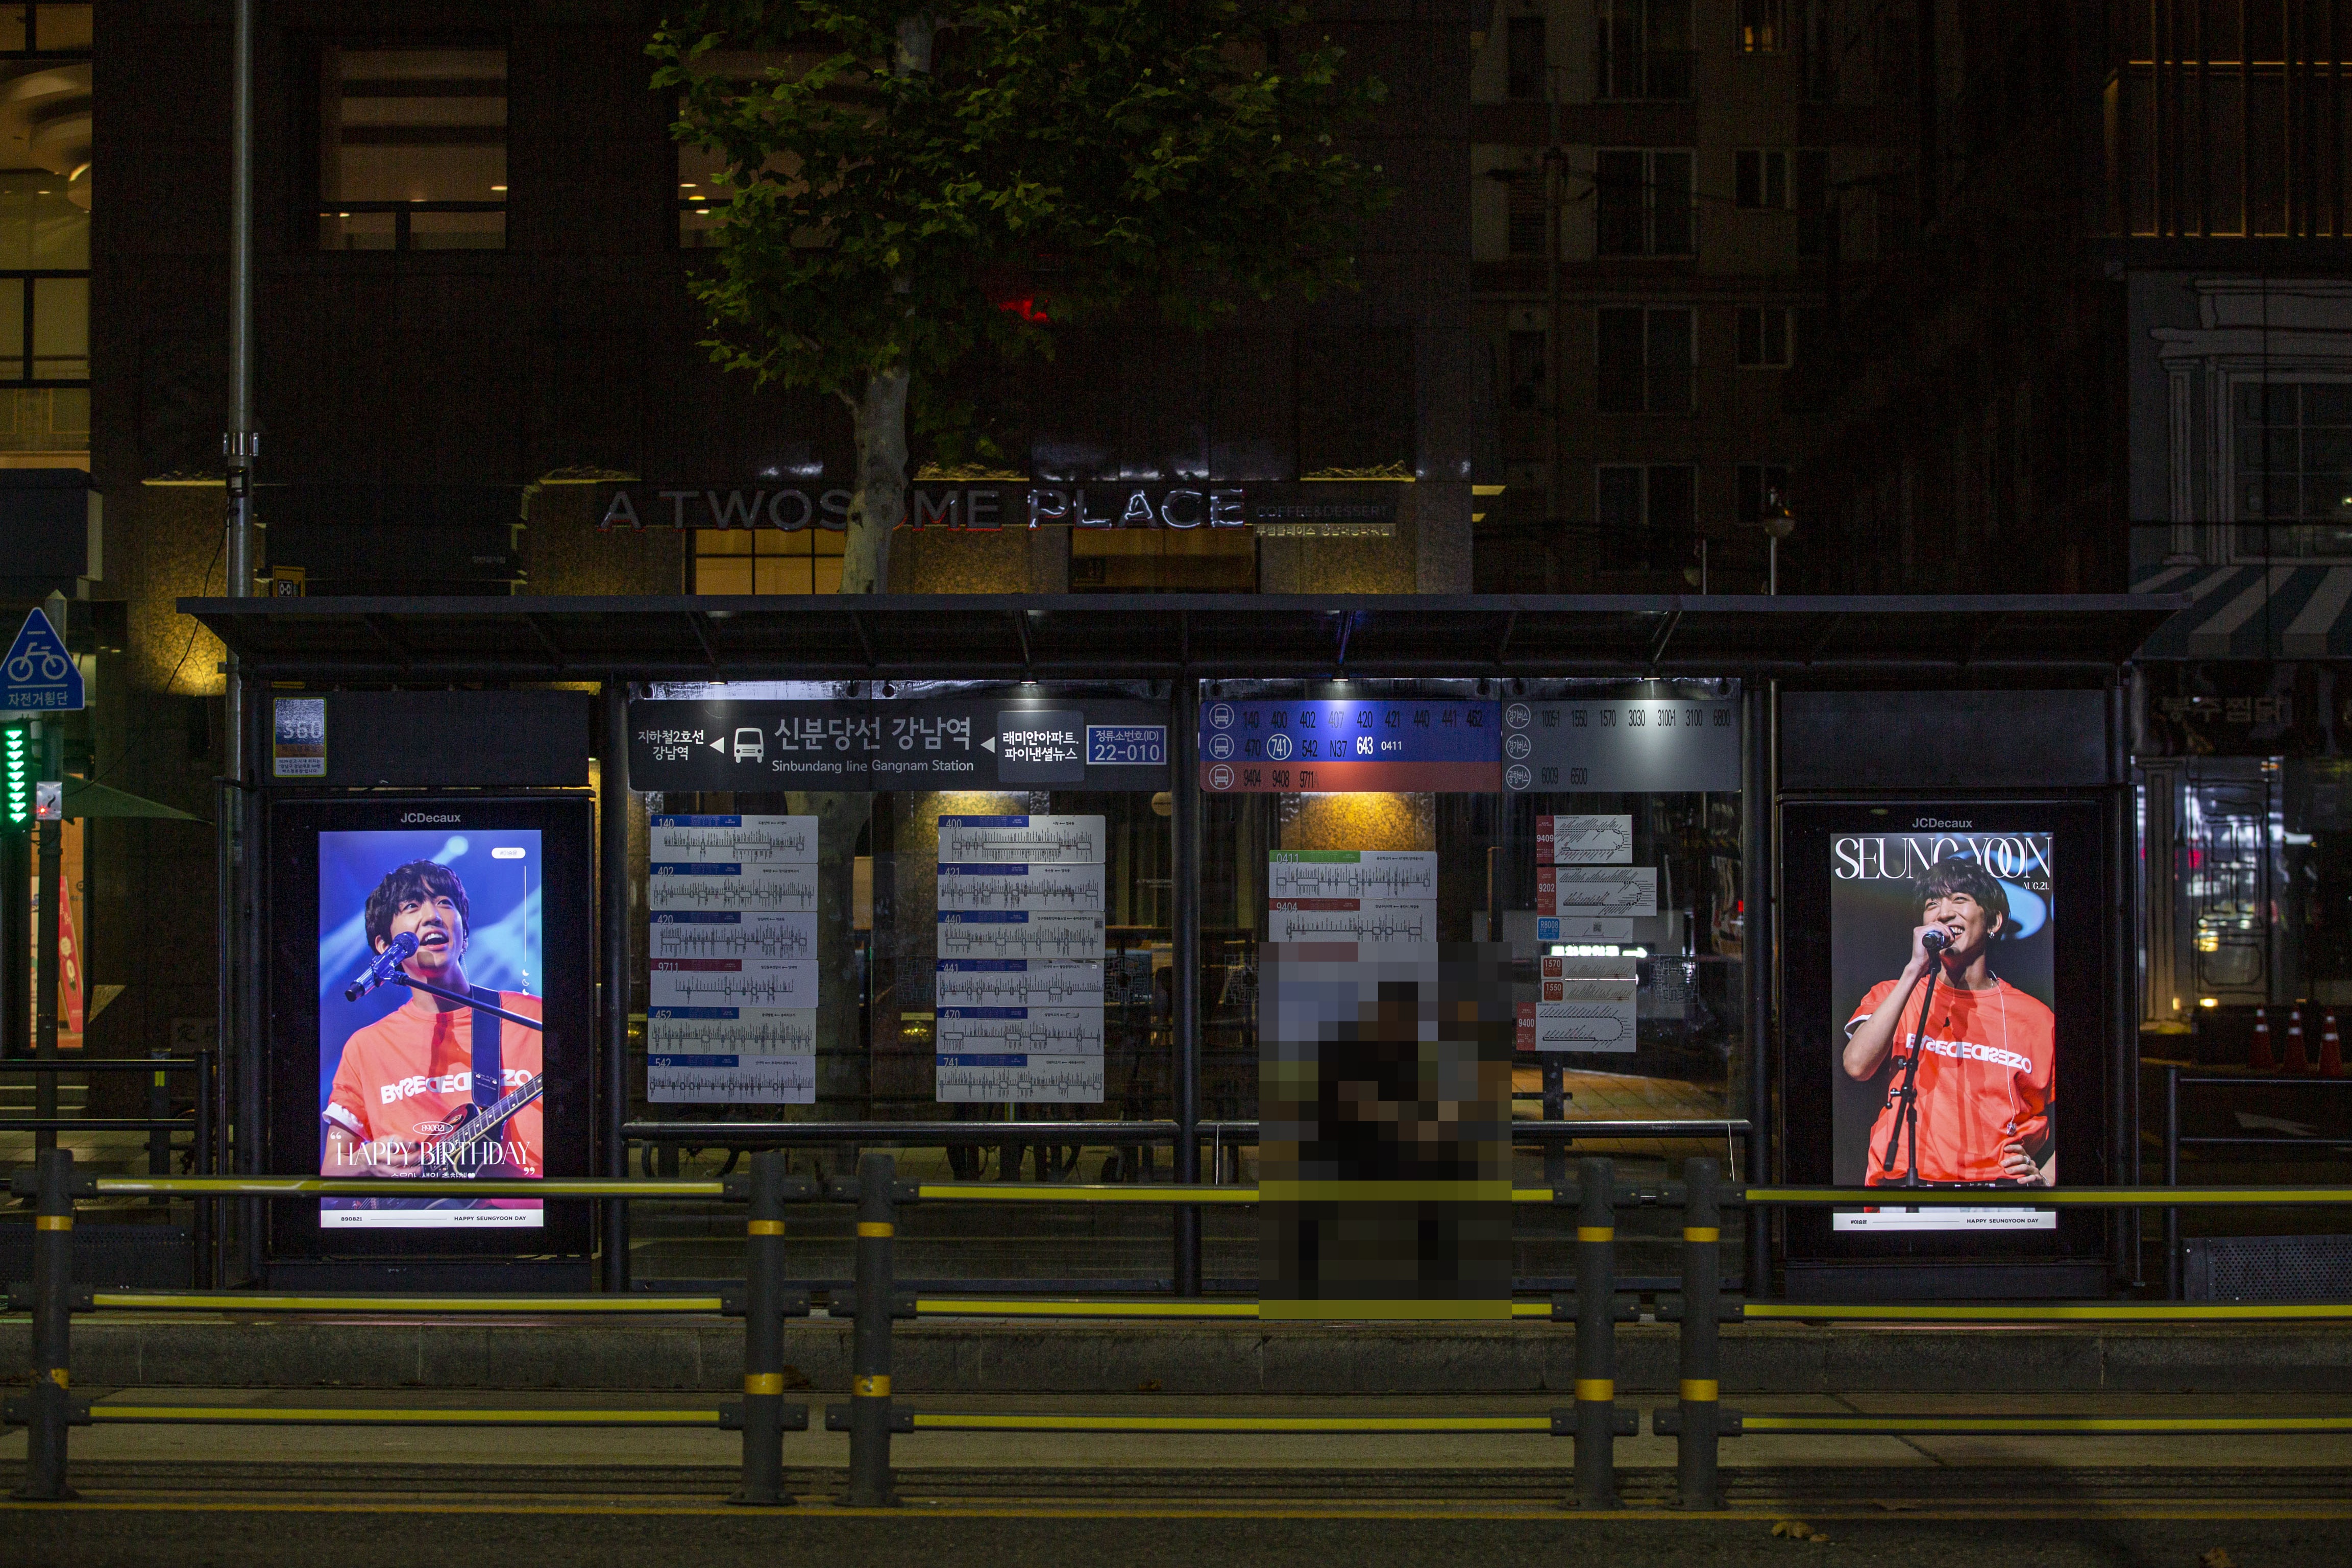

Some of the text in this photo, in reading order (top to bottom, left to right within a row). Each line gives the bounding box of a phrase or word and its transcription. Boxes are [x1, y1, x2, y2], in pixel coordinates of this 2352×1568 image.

[598, 487, 1246, 532] A TWOSME PLACE
[1257, 525, 1316, 536] 투썸플레이스
[8, 691, 68, 707] 자전거횡단
[1271, 711, 1287, 728] 400
[1300, 711, 1316, 728] 402
[1328, 710, 1344, 728] 407
[1357, 711, 1373, 728] 420
[1385, 711, 1401, 728] 421
[1413, 711, 1430, 728] 440
[1441, 710, 1457, 727] 441
[1508, 709, 1528, 723] 경기버스
[1572, 709, 1588, 727] 1550
[1600, 709, 1616, 727] 1570
[1628, 709, 1645, 727] 3030
[1657, 709, 1676, 727] 3100-1
[1685, 709, 1703, 726] 3100
[1713, 708, 1730, 727] 6800
[638, 730, 704, 746] 지하철2호선
[774, 716, 971, 751] 신분당선 강남역
[1096, 729, 1159, 743] 정류소번호(ID)
[1245, 736, 1402, 757] 470 741 542 N37 643 0411
[1508, 740, 1528, 753] 경기버스
[653, 746, 689, 761] 강남역
[1004, 746, 1077, 762] 파이낸셜뉴스
[1095, 744, 1160, 762] 22-010
[772, 760, 974, 775] Sinbundang line Gangnam Station
[1244, 770, 1261, 787] 9404
[1272, 770, 1290, 788] 9408
[1508, 771, 1528, 784] 공항버스
[1571, 767, 1588, 785] 6500
[401, 813, 461, 823] JCDecaux
[658, 818, 674, 828] 140
[1912, 818, 1972, 828] JCDecaux
[946, 819, 963, 829] 400
[1276, 853, 1299, 864] 0411
[657, 866, 674, 876] 402
[945, 867, 960, 878] 421
[1538, 884, 1555, 892] 9202
[1276, 902, 1298, 913] 9404
[657, 915, 674, 925] 420
[945, 915, 961, 925] 440
[658, 962, 679, 972] 9711
[943, 963, 959, 973] 441
[655, 1010, 672, 1020] 452
[944, 1010, 961, 1020] 470
[1518, 1018, 1534, 1027] 9400
[655, 1058, 672, 1069] 542
[943, 1058, 959, 1068] 741
[422, 1124, 445, 1132] 890821
[337, 1141, 531, 1166] HAPPY BIRTHDAY
